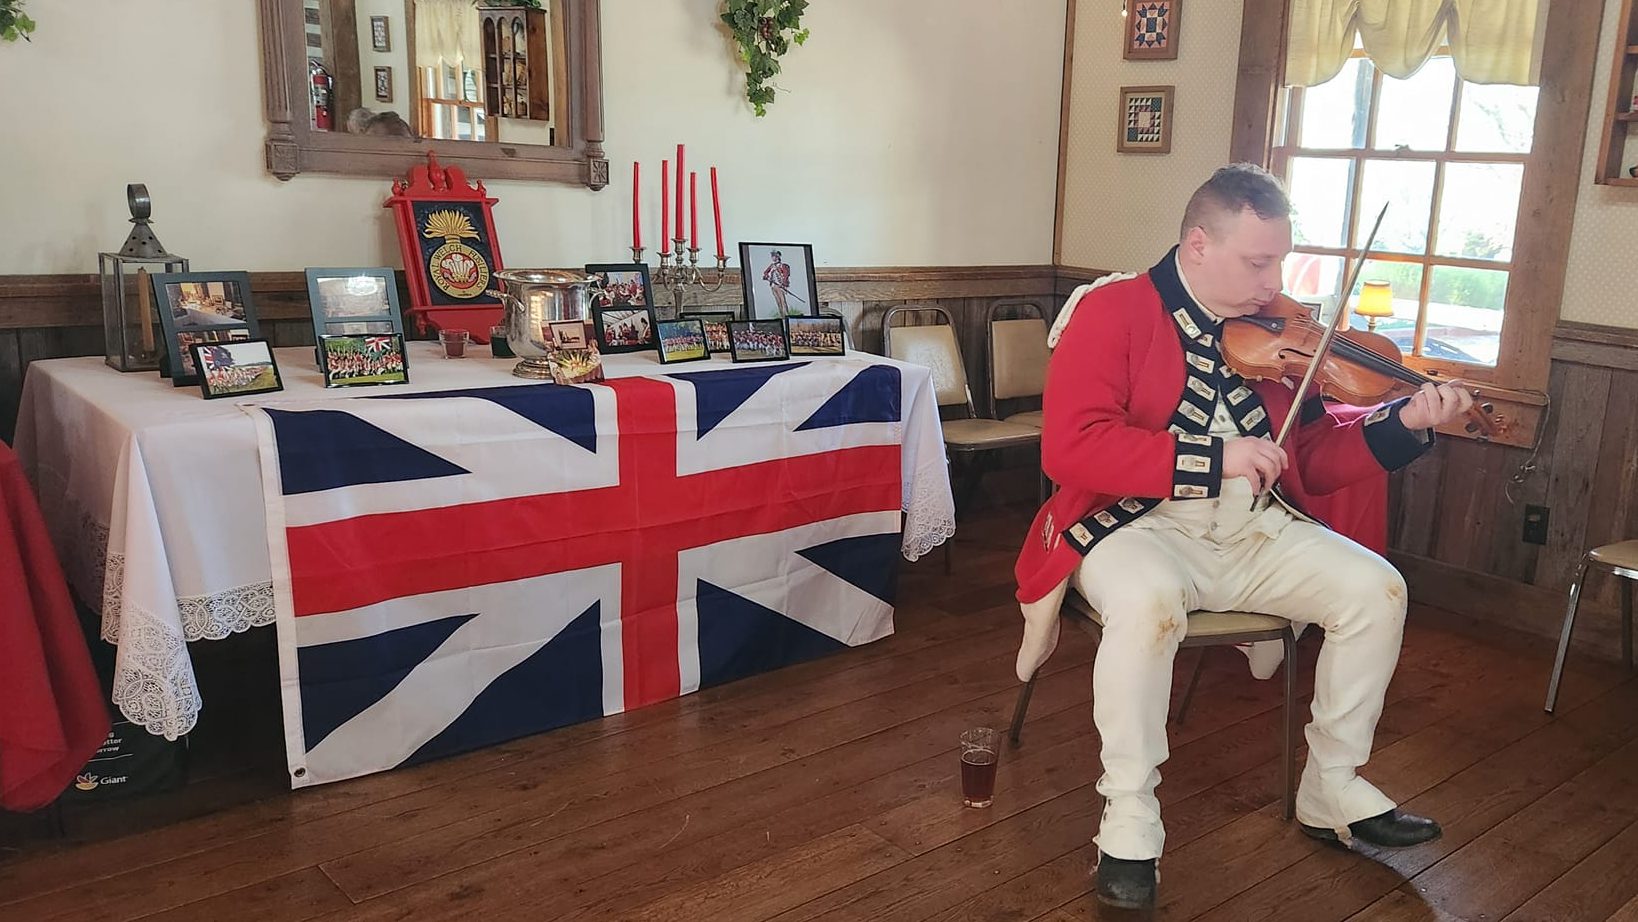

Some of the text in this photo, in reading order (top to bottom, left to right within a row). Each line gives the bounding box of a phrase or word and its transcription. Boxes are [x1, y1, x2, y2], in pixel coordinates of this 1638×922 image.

[431, 244, 488, 291] ROYAL WELCH FUSILIERS
[100, 776, 128, 785] Giant
